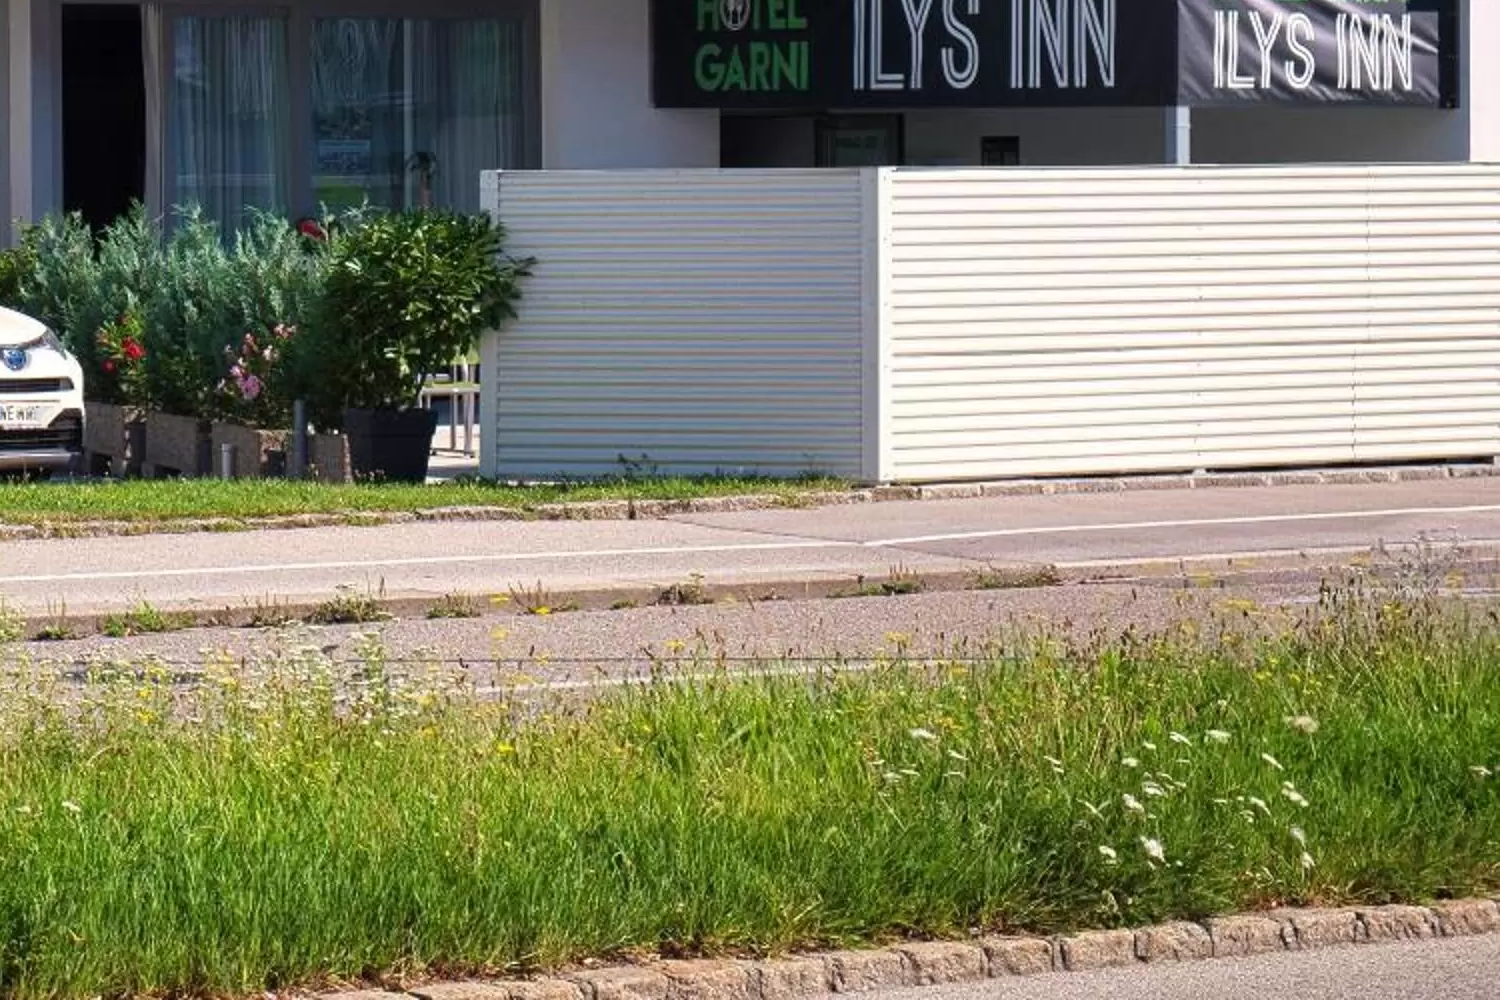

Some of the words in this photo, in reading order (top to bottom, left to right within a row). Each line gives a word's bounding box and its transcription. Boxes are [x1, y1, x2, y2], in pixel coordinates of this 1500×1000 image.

[695, 40, 809, 91] GARNI
[1213, 10, 1315, 89] ILYS
[1336, 12, 1413, 90] INN
